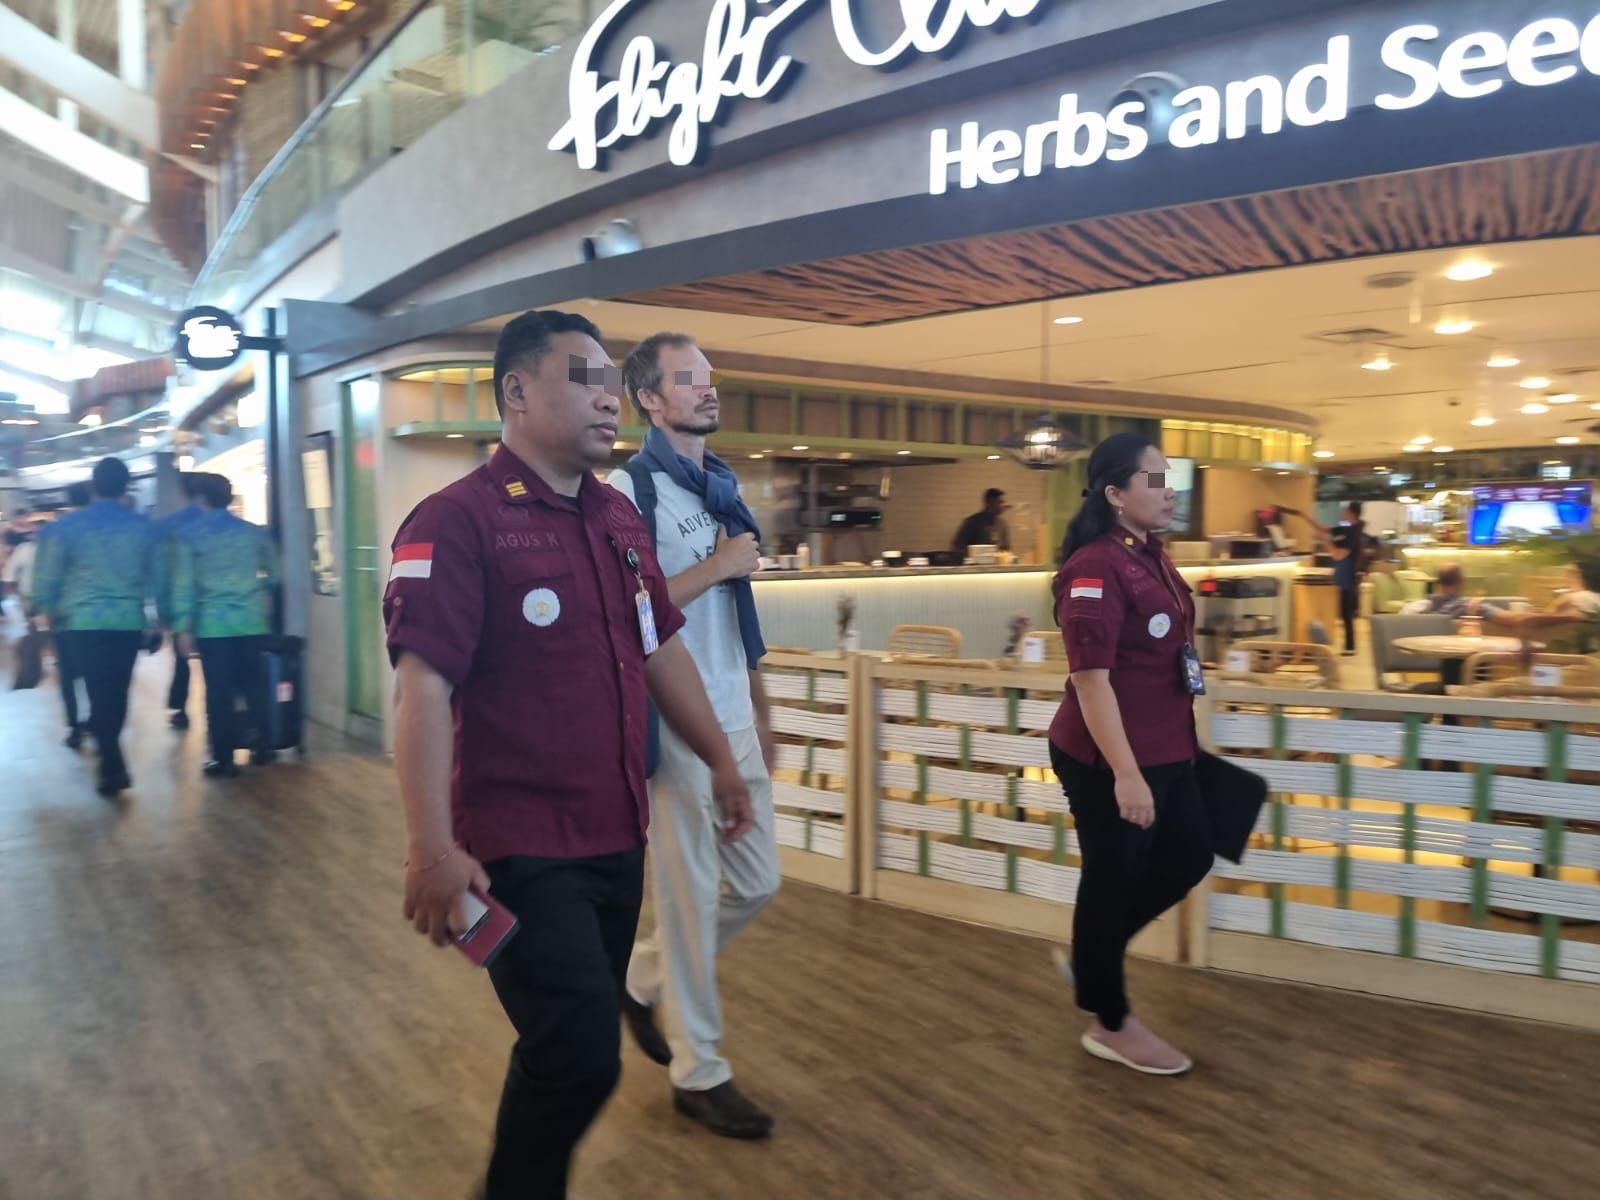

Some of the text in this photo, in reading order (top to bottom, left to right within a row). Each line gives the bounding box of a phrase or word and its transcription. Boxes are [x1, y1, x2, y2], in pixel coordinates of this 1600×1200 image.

[929, 93, 1148, 195] Herbs
[1167, 34, 1350, 149] and
[677, 510, 717, 539] ADVE
[495, 532, 541, 550] AGUS
